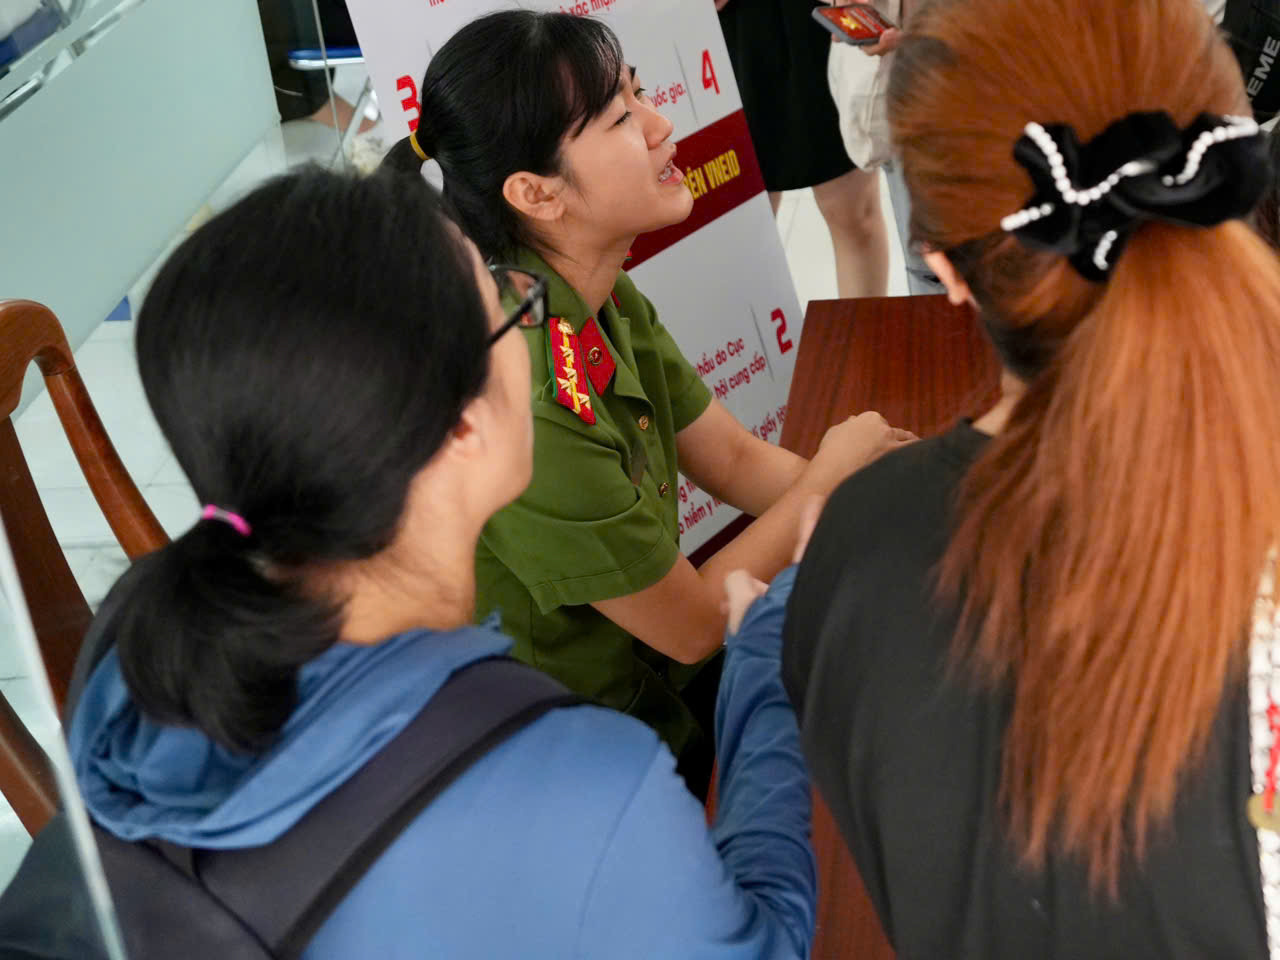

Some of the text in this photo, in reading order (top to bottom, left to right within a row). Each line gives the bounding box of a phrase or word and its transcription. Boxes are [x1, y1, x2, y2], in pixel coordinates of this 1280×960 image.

[651, 82, 686, 107] uốc gia.
[702, 49, 720, 95] 4
[396, 74, 422, 132] 3
[683, 149, 741, 200] ÊN VNEID
[771, 307, 794, 355] 2
[694, 338, 745, 377] hẩu do Cục
[714, 351, 767, 400] hội cung cấp
[683, 501, 706, 529] hiểm
[706, 500, 713, 516] y
